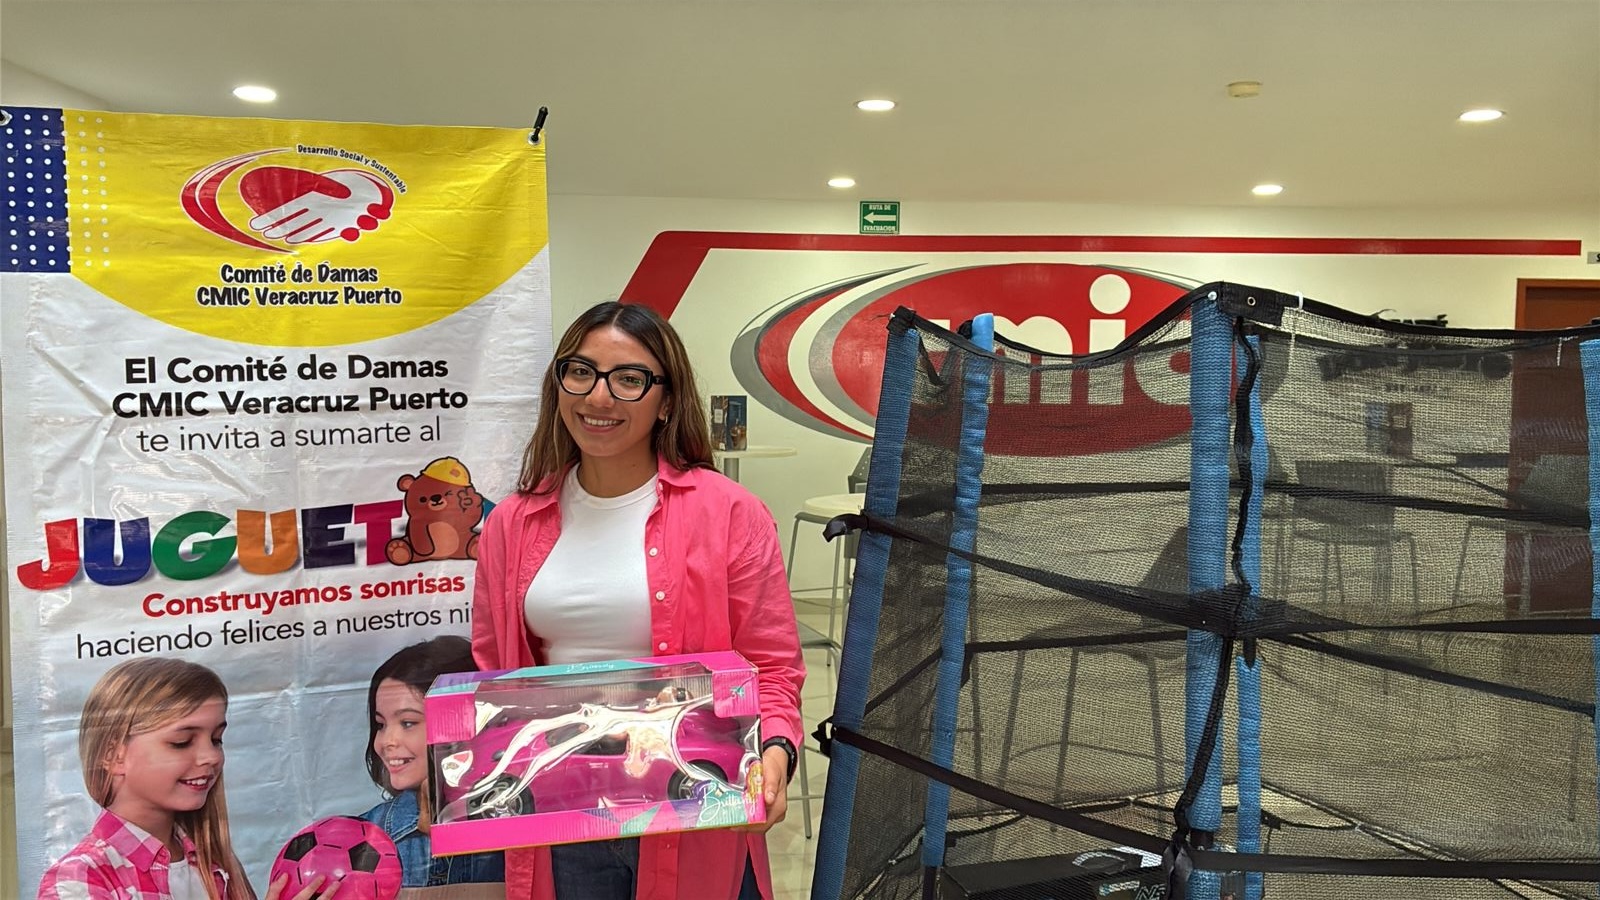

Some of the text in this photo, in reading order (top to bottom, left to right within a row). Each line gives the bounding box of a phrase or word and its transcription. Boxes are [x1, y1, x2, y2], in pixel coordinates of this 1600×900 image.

[297, 144, 339, 156] Desarrollo
[339, 149, 364, 162] Social
[371, 159, 407, 194] Sustentable
[221, 263, 378, 284] Comité de Damas
[197, 286, 402, 306] CMIC Veracruz Puerto
[125, 353, 449, 384] El Comité de Damas
[112, 386, 468, 419] CMIC Veracruz Puerto
[136, 415, 441, 452] te invita a sumarte al
[16, 497, 497, 591] JUGUET
[142, 572, 465, 618] Construyamos sonrisas
[77, 602, 474, 660] haciendo felices a nuestros ni
